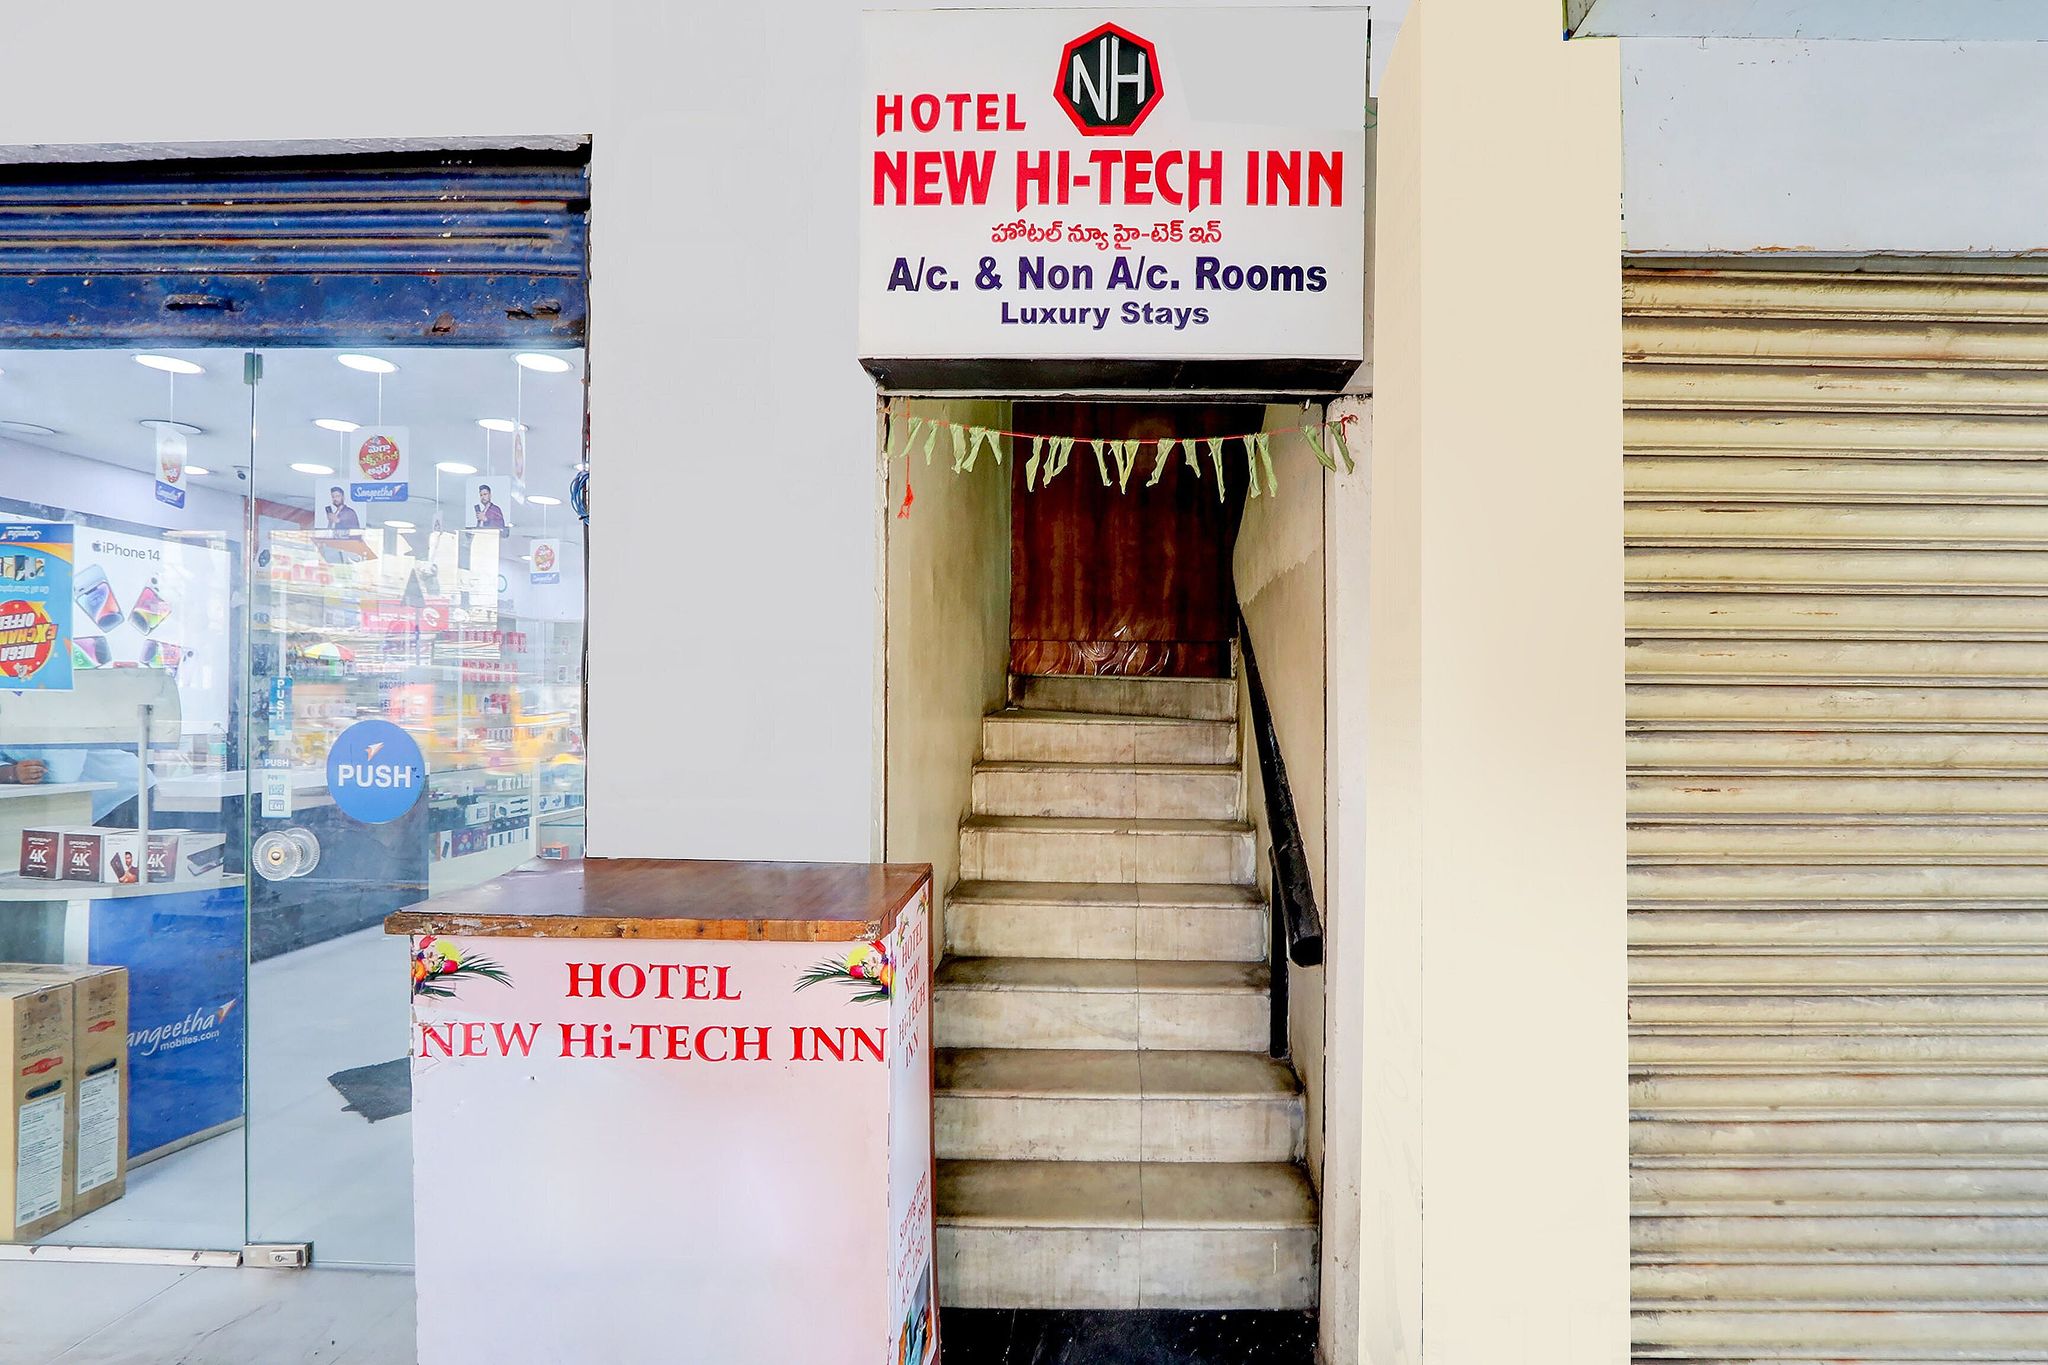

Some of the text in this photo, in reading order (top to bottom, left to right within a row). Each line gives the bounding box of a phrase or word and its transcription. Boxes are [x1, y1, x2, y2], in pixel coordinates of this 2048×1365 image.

[1073, 36, 1146, 121] NH
[876, 94, 1027, 137] HOTEL
[873, 150, 1343, 212] NEW HI-TECH INN
[991, 219, 1222, 250] హోటల్ న్యూ హై-టెక్ ఇన్
[887, 256, 1328, 292] A/c. & Non A/c. Rooms
[1000, 302, 1210, 330] Luxury Stays
[103, 542, 160, 561] iPhone 14
[0, 644, 38, 661] MEGA
[276, 680, 285, 720] PUSH
[265, 759, 289, 768] PUSH
[338, 764, 411, 788] PUSH
[29, 849, 47, 863] 4K
[72, 853, 90, 866] 4K
[147, 854, 165, 867] 4K
[565, 962, 743, 1000] HOTEL
[126, 1007, 215, 1056] angeetha
[160, 1030, 220, 1051] mobiles.com
[418, 1022, 888, 1062] NEW Hi-TECH INN
